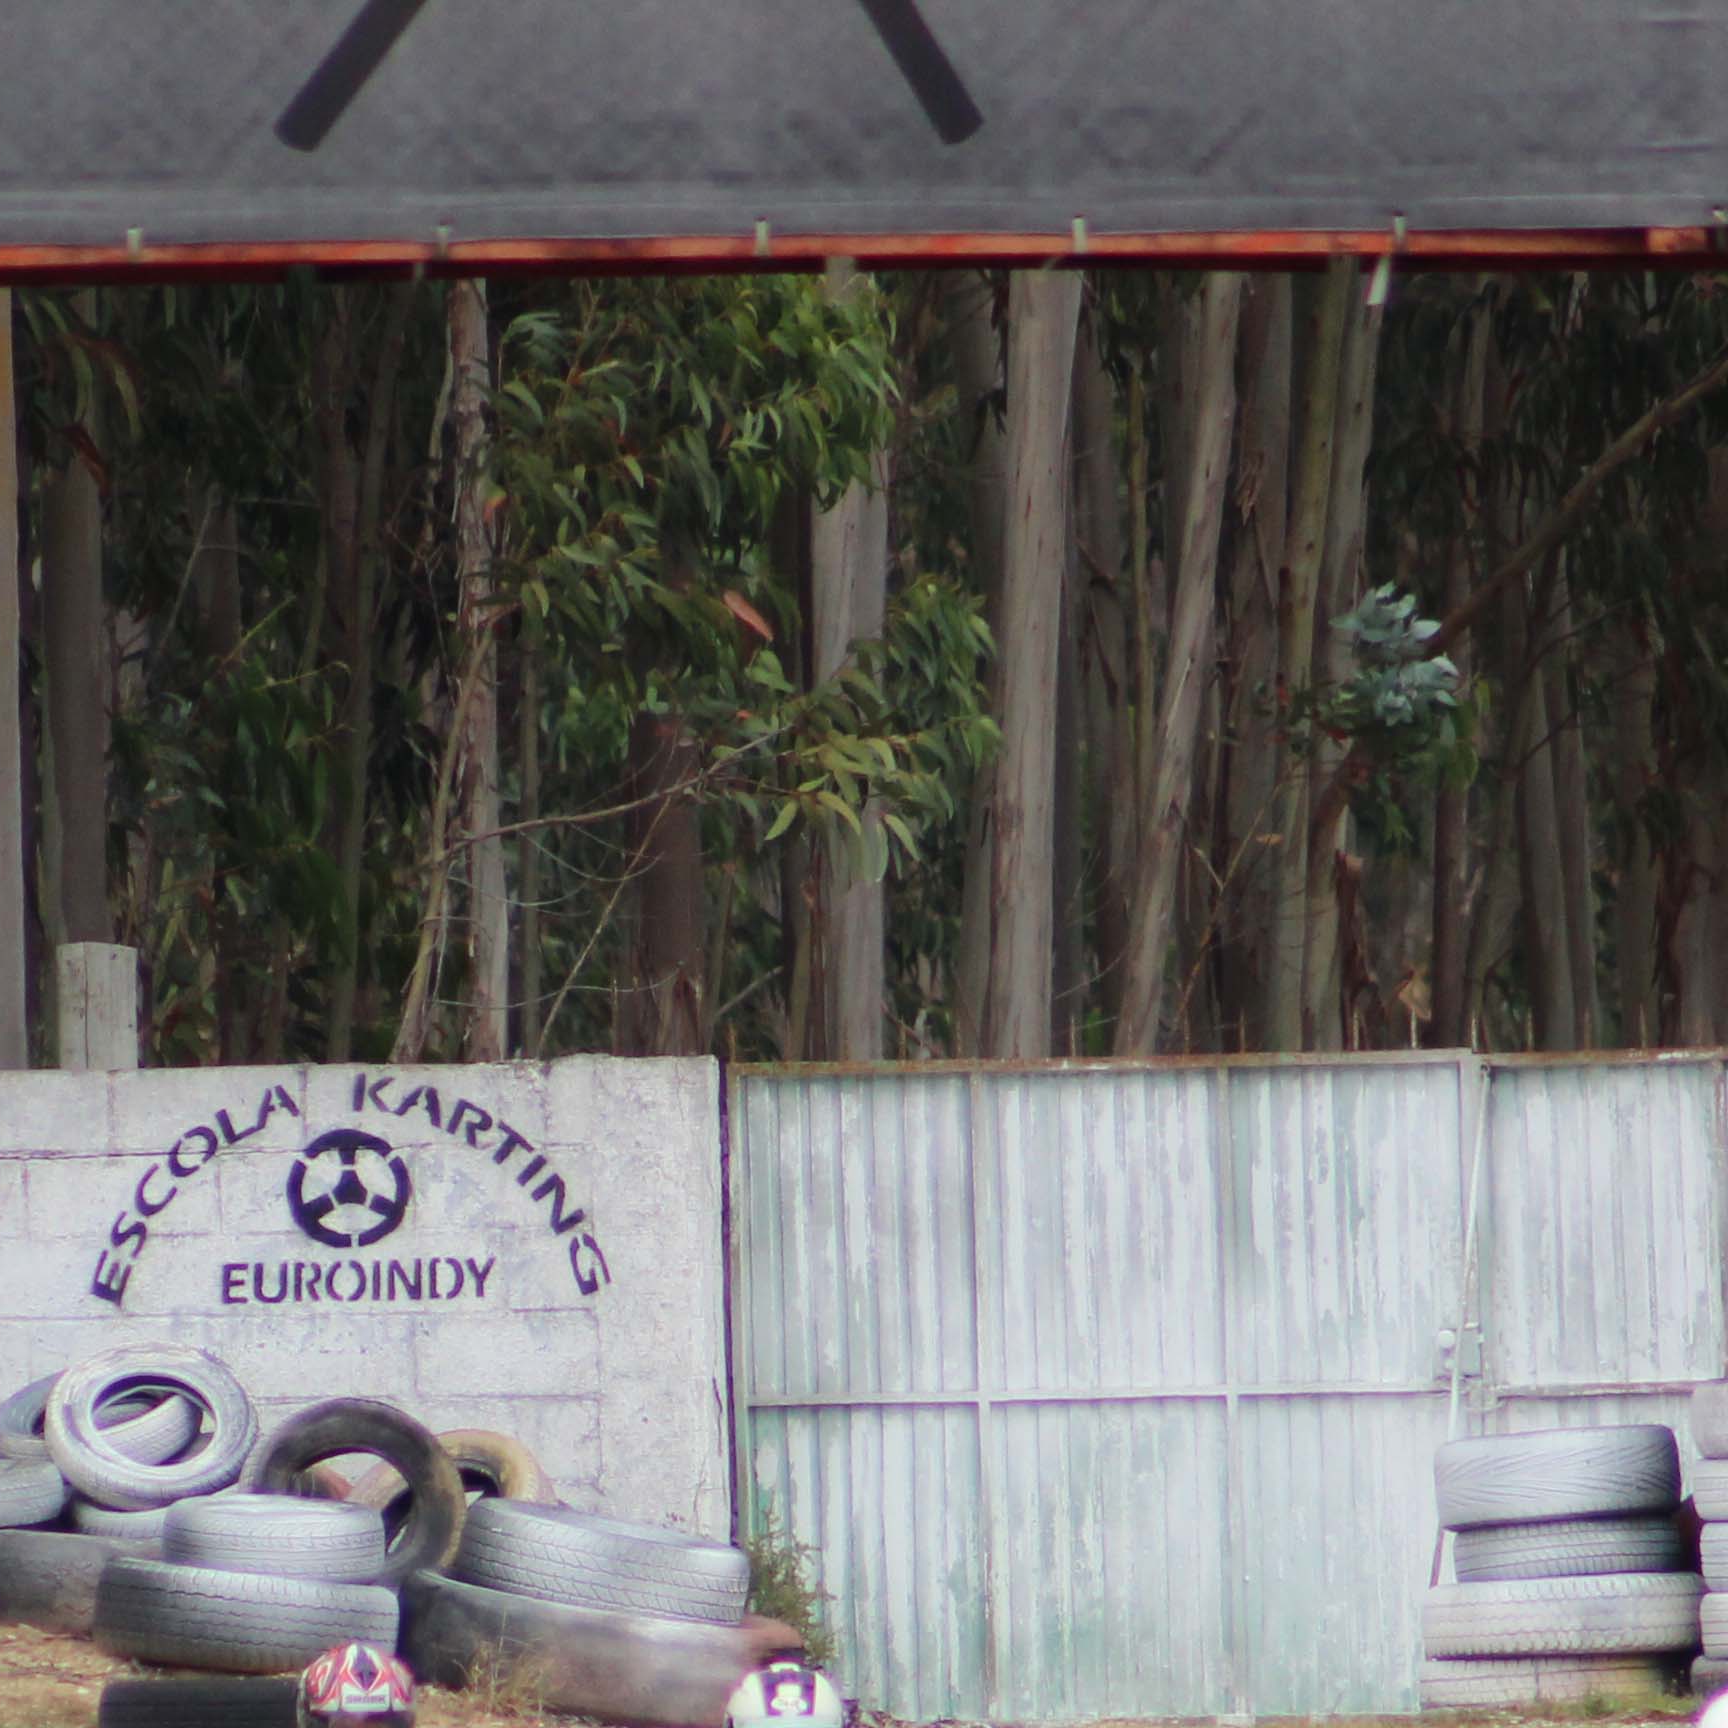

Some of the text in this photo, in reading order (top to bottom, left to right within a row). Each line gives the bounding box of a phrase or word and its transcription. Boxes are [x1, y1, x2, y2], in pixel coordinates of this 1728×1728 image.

[91, 1072, 611, 1306] ESCOLA KARTING
[221, 1257, 495, 1304] EUROINDY
